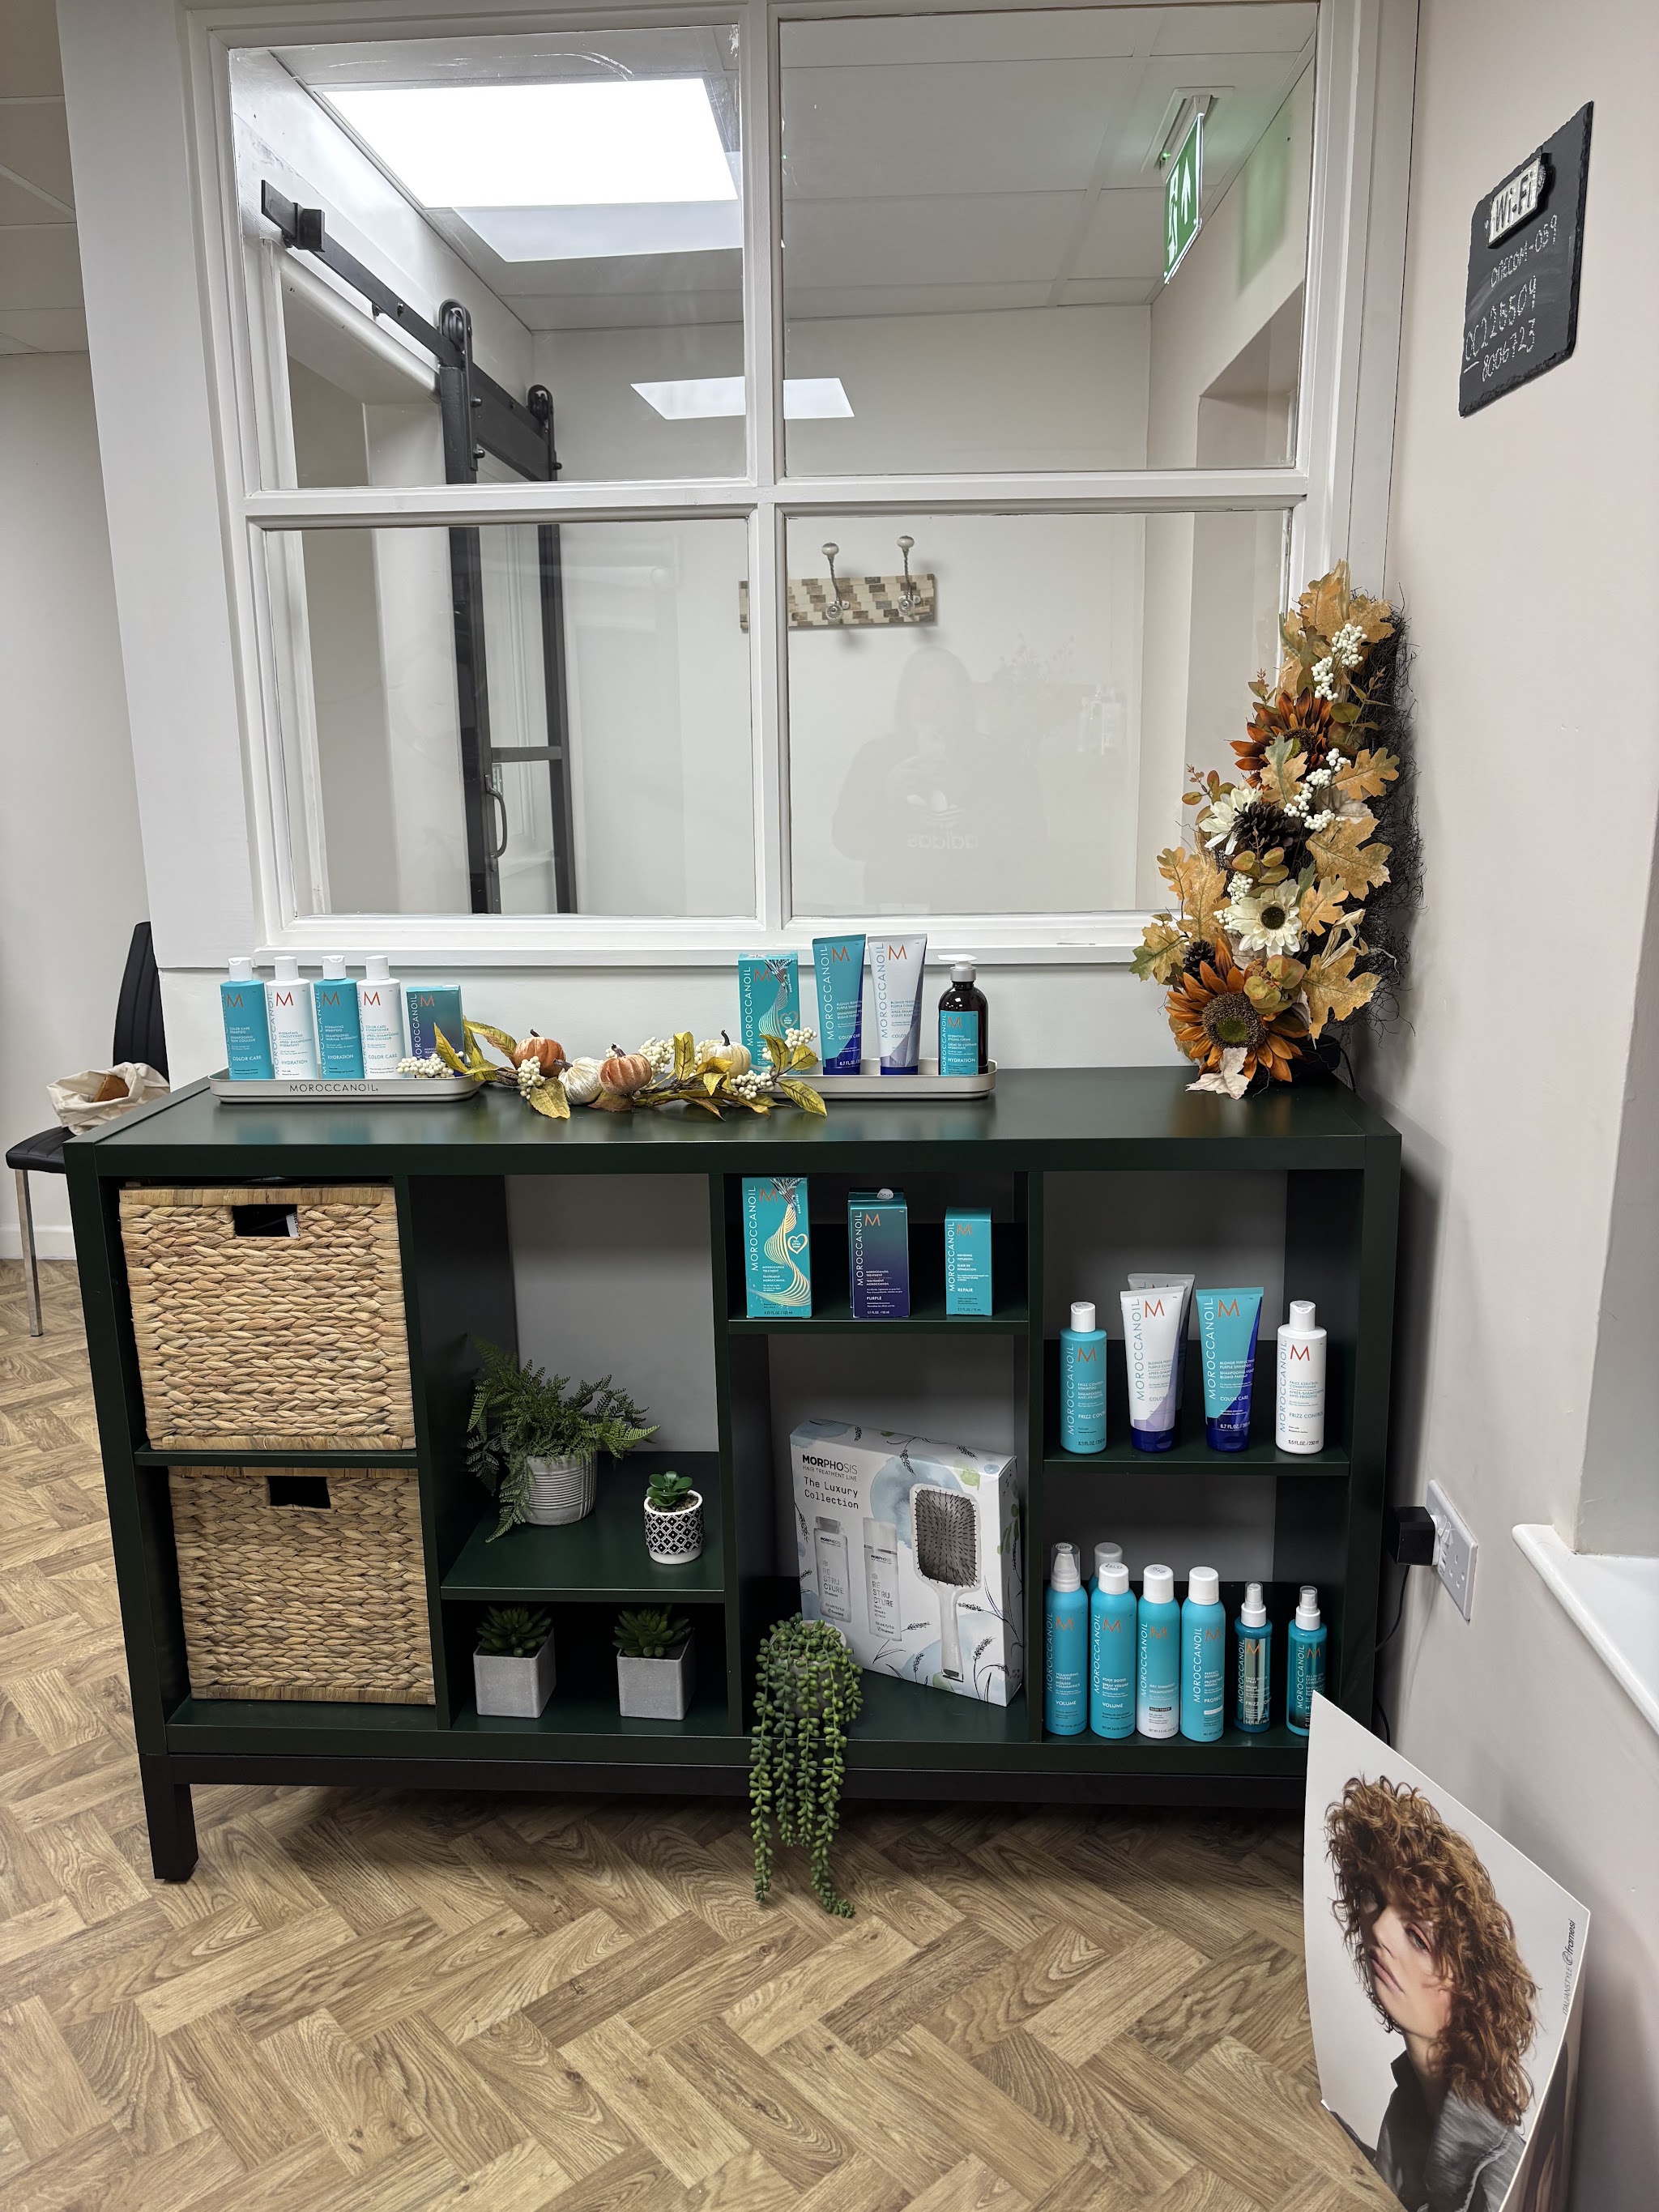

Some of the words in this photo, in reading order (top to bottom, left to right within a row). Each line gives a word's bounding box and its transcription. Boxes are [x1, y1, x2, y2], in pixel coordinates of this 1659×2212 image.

[832, 946, 850, 962] M
[888, 945, 907, 960] M
[754, 968, 771, 982] M
[821, 945, 835, 1040] MOROCCANOIL
[876, 943, 888, 1038] MOROCCANOIL
[227, 993, 244, 1007] M
[276, 992, 293, 1006] M
[322, 991, 339, 1006] M
[364, 991, 380, 1006] M
[420, 995, 435, 1007] M
[743, 967, 754, 1046] MOROCCANOIL
[410, 994, 422, 1059] MOROCCANOIL
[948, 1016, 962, 1028] M
[268, 990, 280, 1075] MOROCCANOIL
[315, 989, 327, 1075] MOROCCANOIL
[289, 1083, 376, 1092] MOROCCANOIL
[759, 1188, 777, 1202] M
[864, 1213, 881, 1226] M
[748, 1185, 759, 1271] MOROCCANOIL
[957, 1223, 972, 1235] M
[855, 1212, 864, 1286] MOROCCANOIL
[1145, 1298, 1165, 1318] M
[1218, 1299, 1239, 1317] M
[1077, 1347, 1096, 1362] M
[1131, 1299, 1145, 1401] MOROCCANOIL
[1204, 1298, 1216, 1400] MOROCCANOIL
[1290, 1345, 1310, 1361] M
[802, 1454, 857, 1474] MORPHOSIS
[816, 1468, 844, 1478] TREATMENT
[804, 1476, 820, 1487] The
[824, 1481, 858, 1498] Luxury
[805, 1489, 858, 1509] Collection
[824, 1576, 839, 1585] STRU
[824, 1583, 844, 1594] CTURE
[873, 1589, 890, 1598] STRU
[874, 1597, 893, 1607] CTURE
[1055, 1616, 1073, 1631] M
[1103, 1618, 1122, 1633] M
[1150, 1626, 1167, 1639] M
[1205, 1628, 1220, 1642] M
[1247, 1644, 1260, 1655] M
[1307, 1647, 1320, 1659] M
[1193, 1628, 1202, 1702] MOROCCANOIL
[1204, 1695, 1222, 1703] PROTECT
[1564, 1918, 1576, 1955] framesi
[1562, 1965, 1572, 2015] ITALIANSTYLE
